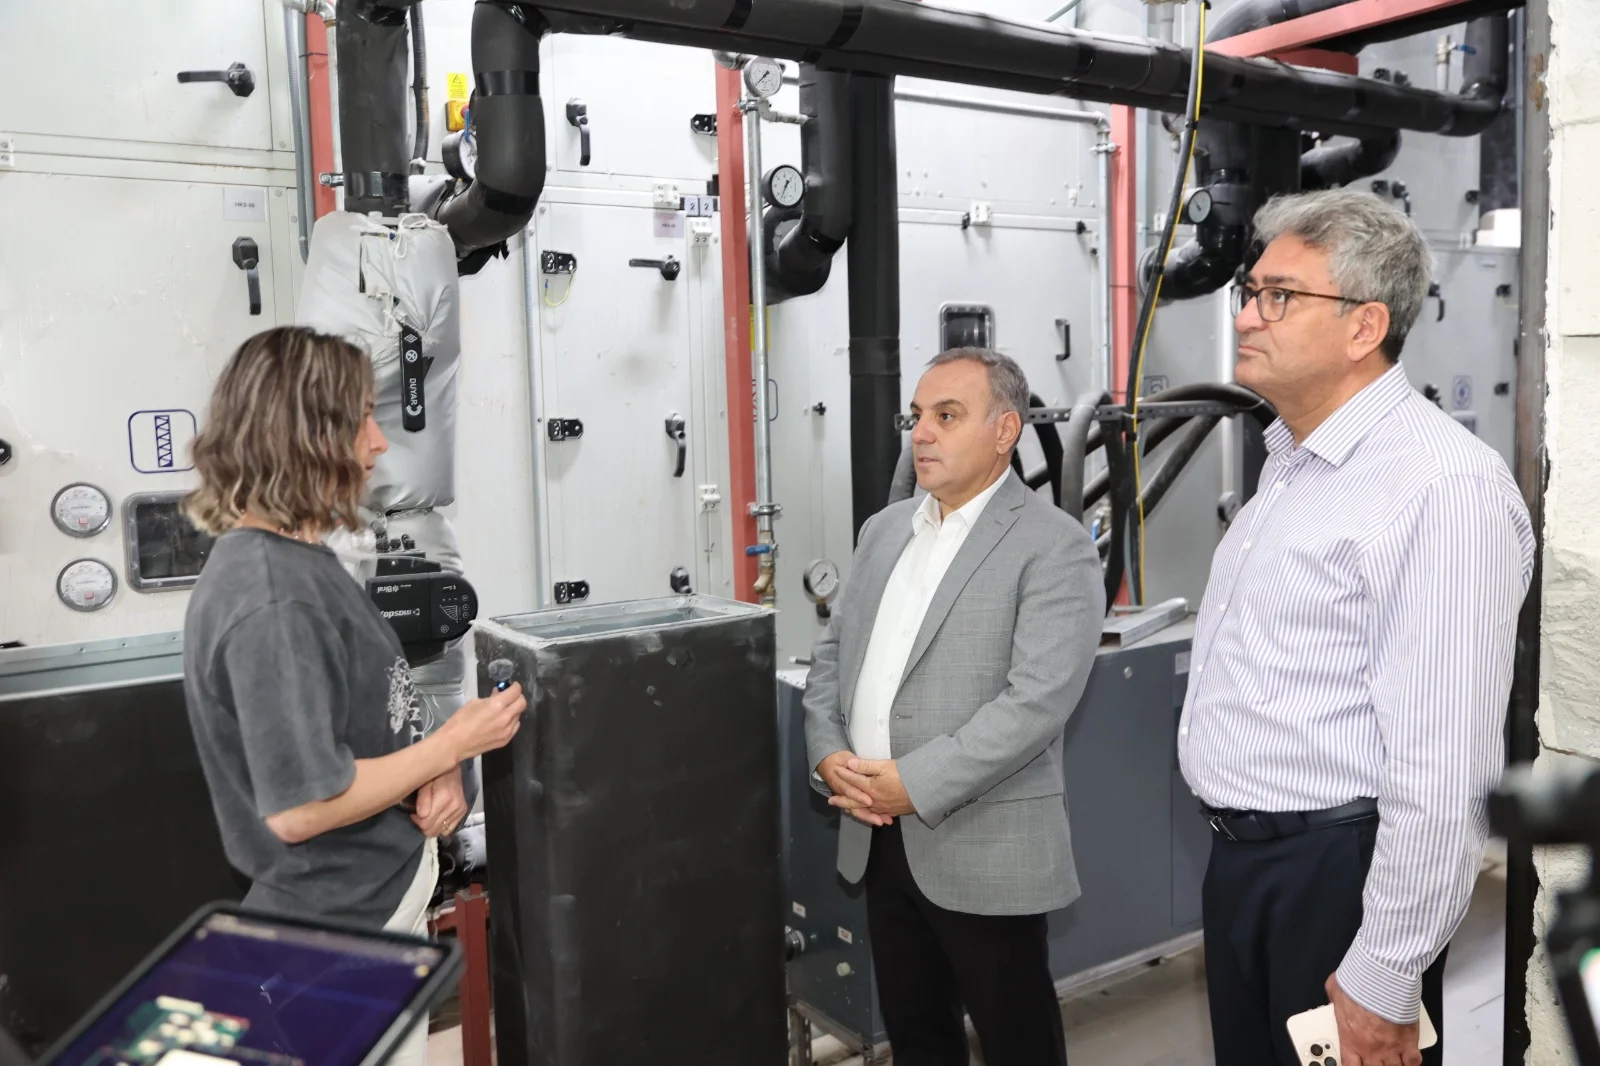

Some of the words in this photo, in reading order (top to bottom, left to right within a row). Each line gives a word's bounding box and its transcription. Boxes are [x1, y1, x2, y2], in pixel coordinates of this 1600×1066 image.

[690, 202, 696, 211] 2
[704, 202, 710, 211] 2
[409, 377, 418, 406] DUYAR
